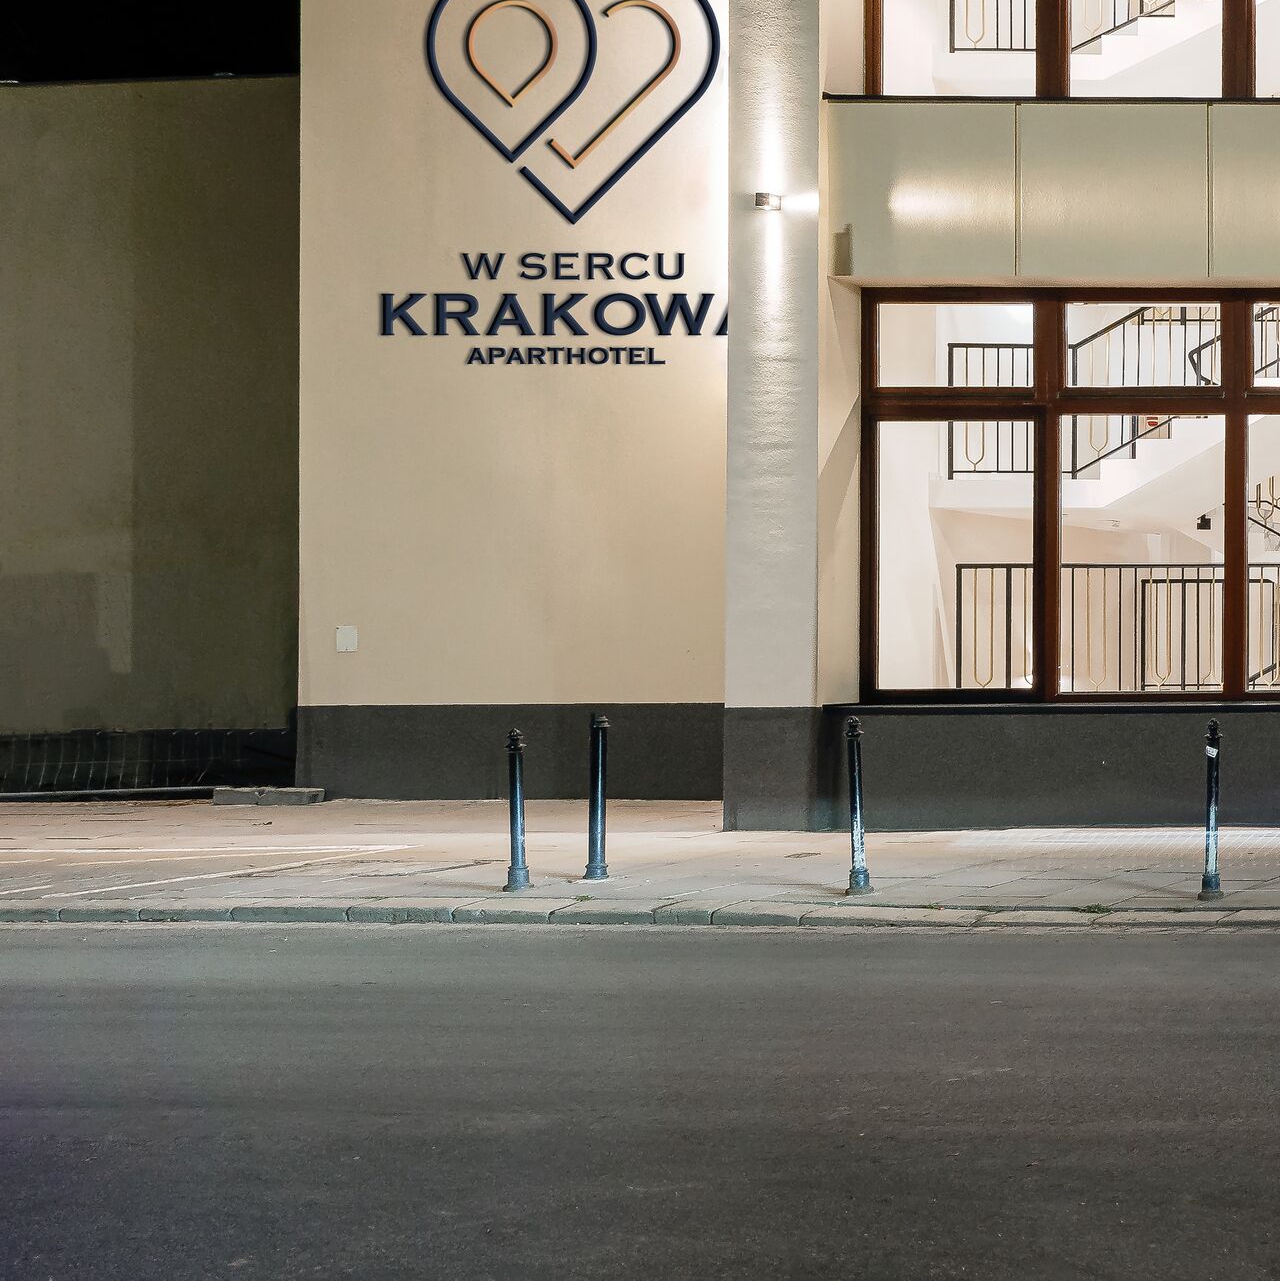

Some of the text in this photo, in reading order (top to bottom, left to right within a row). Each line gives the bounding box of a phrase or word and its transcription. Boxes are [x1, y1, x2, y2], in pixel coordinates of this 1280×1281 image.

[462, 252, 686, 280] W SERCU
[379, 293, 728, 336] KRAKOW
[466, 347, 666, 366] APARTHOTEL
